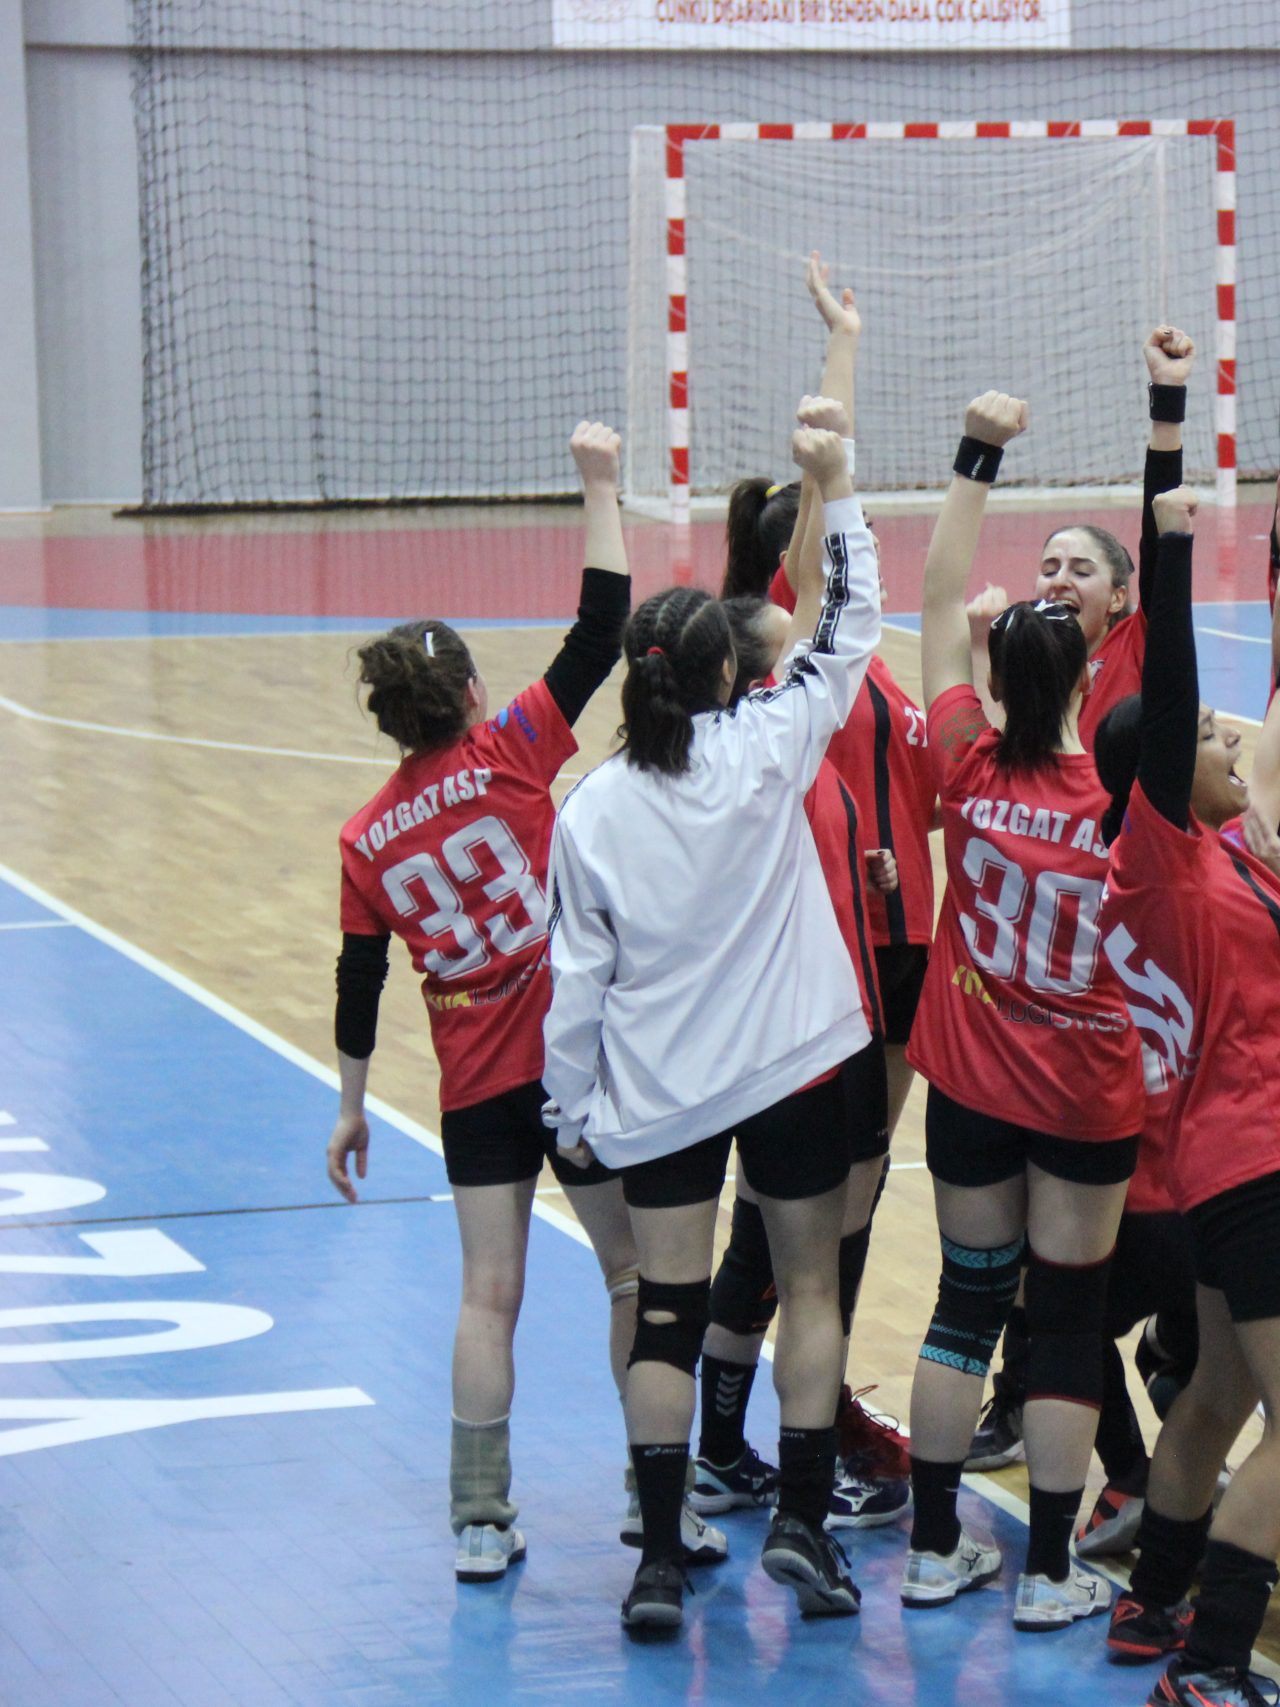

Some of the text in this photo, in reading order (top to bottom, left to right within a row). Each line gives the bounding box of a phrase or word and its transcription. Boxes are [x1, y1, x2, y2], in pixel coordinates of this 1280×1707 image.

[889, 0, 931, 22] DAHA
[354, 768, 492, 862] YOZGAT ASP
[960, 796, 1109, 859] YOZGAT AS
[381, 815, 548, 981] 33
[959, 836, 1103, 997] 30
